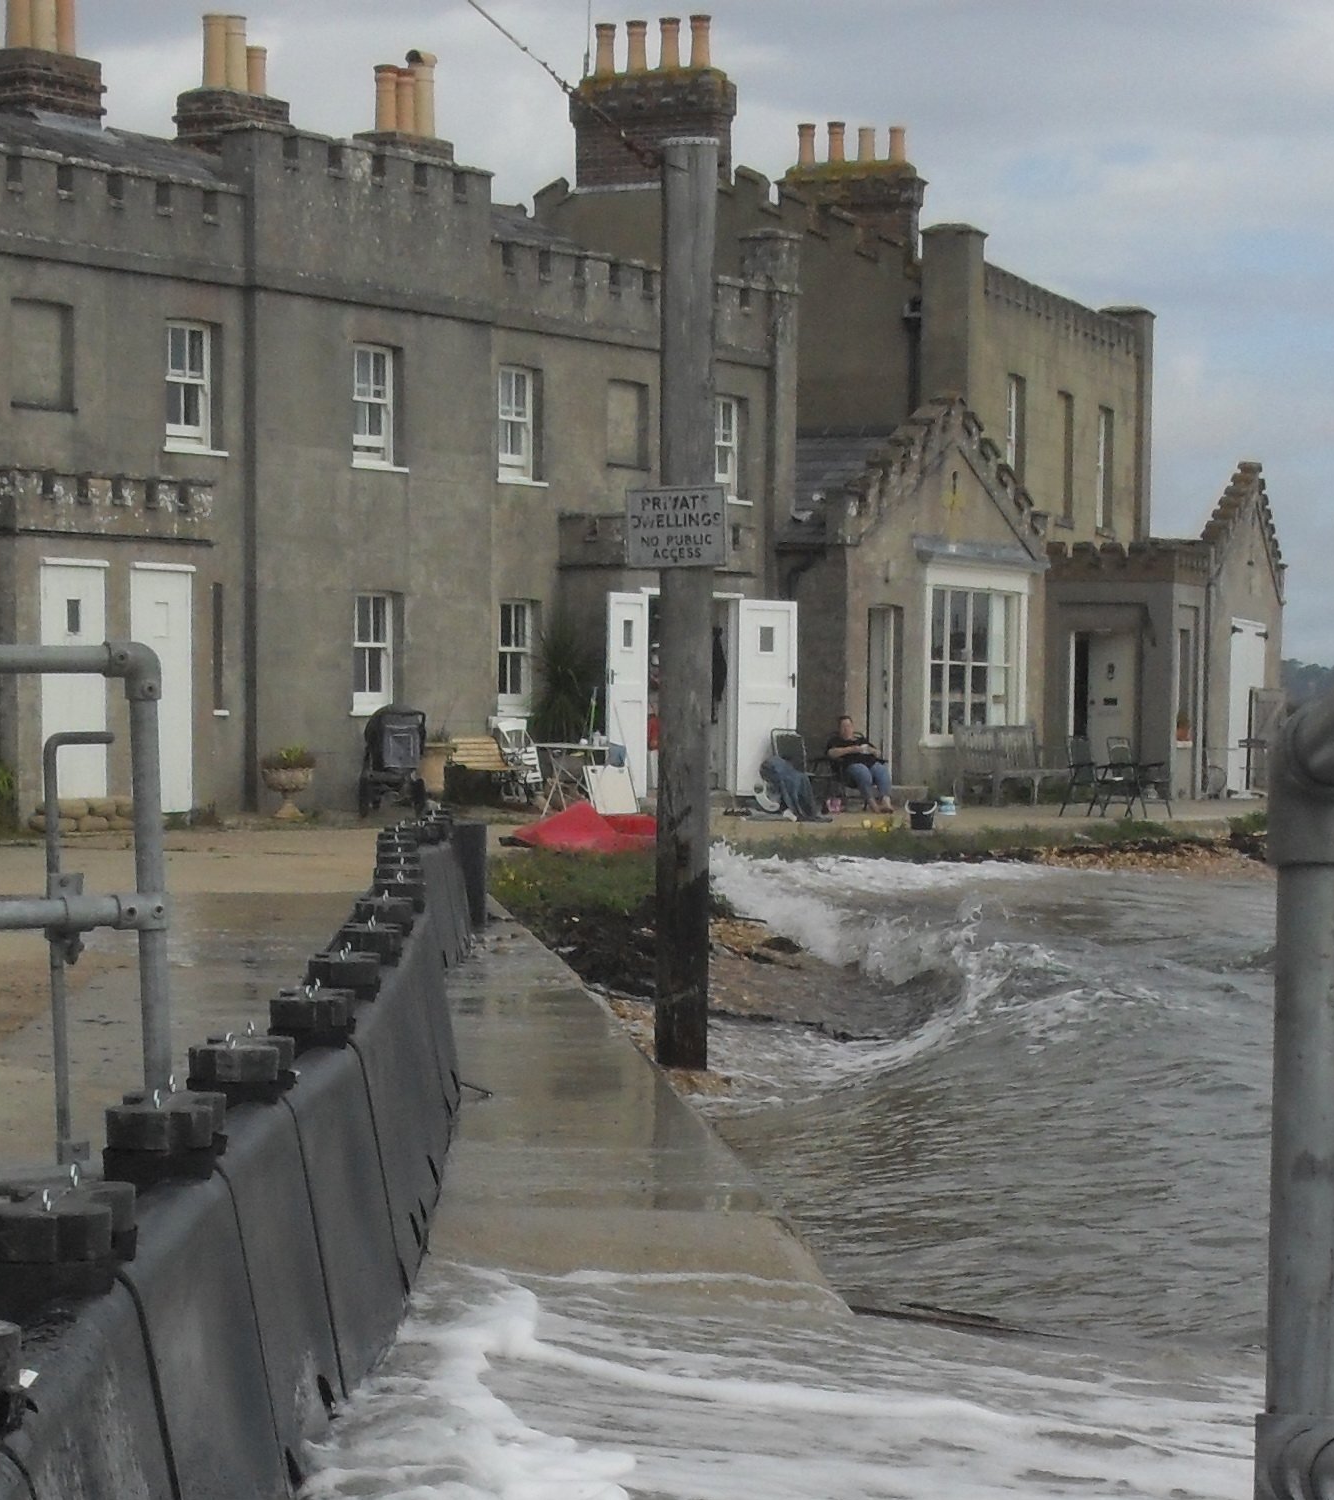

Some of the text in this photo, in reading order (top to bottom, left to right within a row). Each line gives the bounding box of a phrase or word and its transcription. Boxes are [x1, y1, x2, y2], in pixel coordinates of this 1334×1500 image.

[630, 512, 721, 529] DWELLINGS
[640, 534, 712, 547] NO PUBLIC
[653, 547, 702, 559] ACCESS
